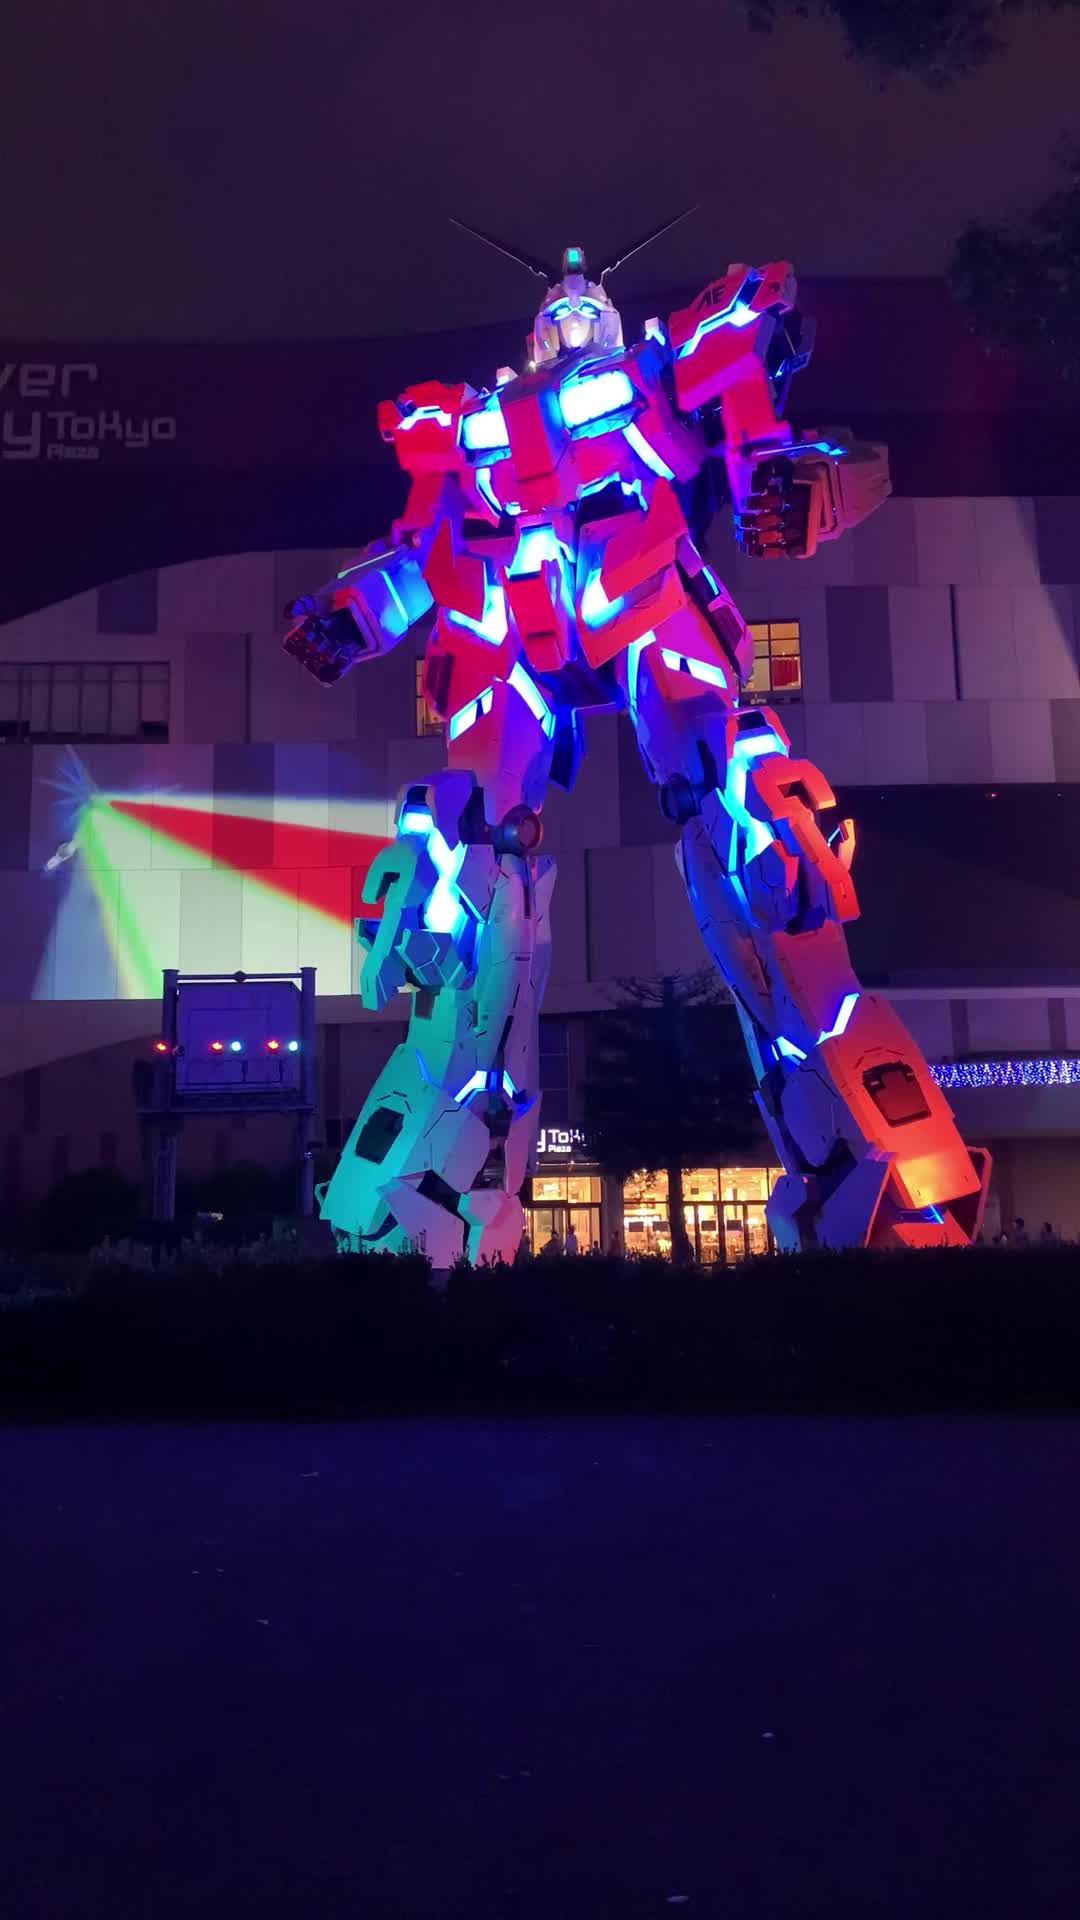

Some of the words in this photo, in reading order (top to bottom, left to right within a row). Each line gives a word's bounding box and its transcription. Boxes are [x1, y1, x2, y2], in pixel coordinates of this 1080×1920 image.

[47, 410, 177, 449] Tokyo
[47, 443, 101, 460] Plaza
[548, 1144, 572, 1152] Plaza
